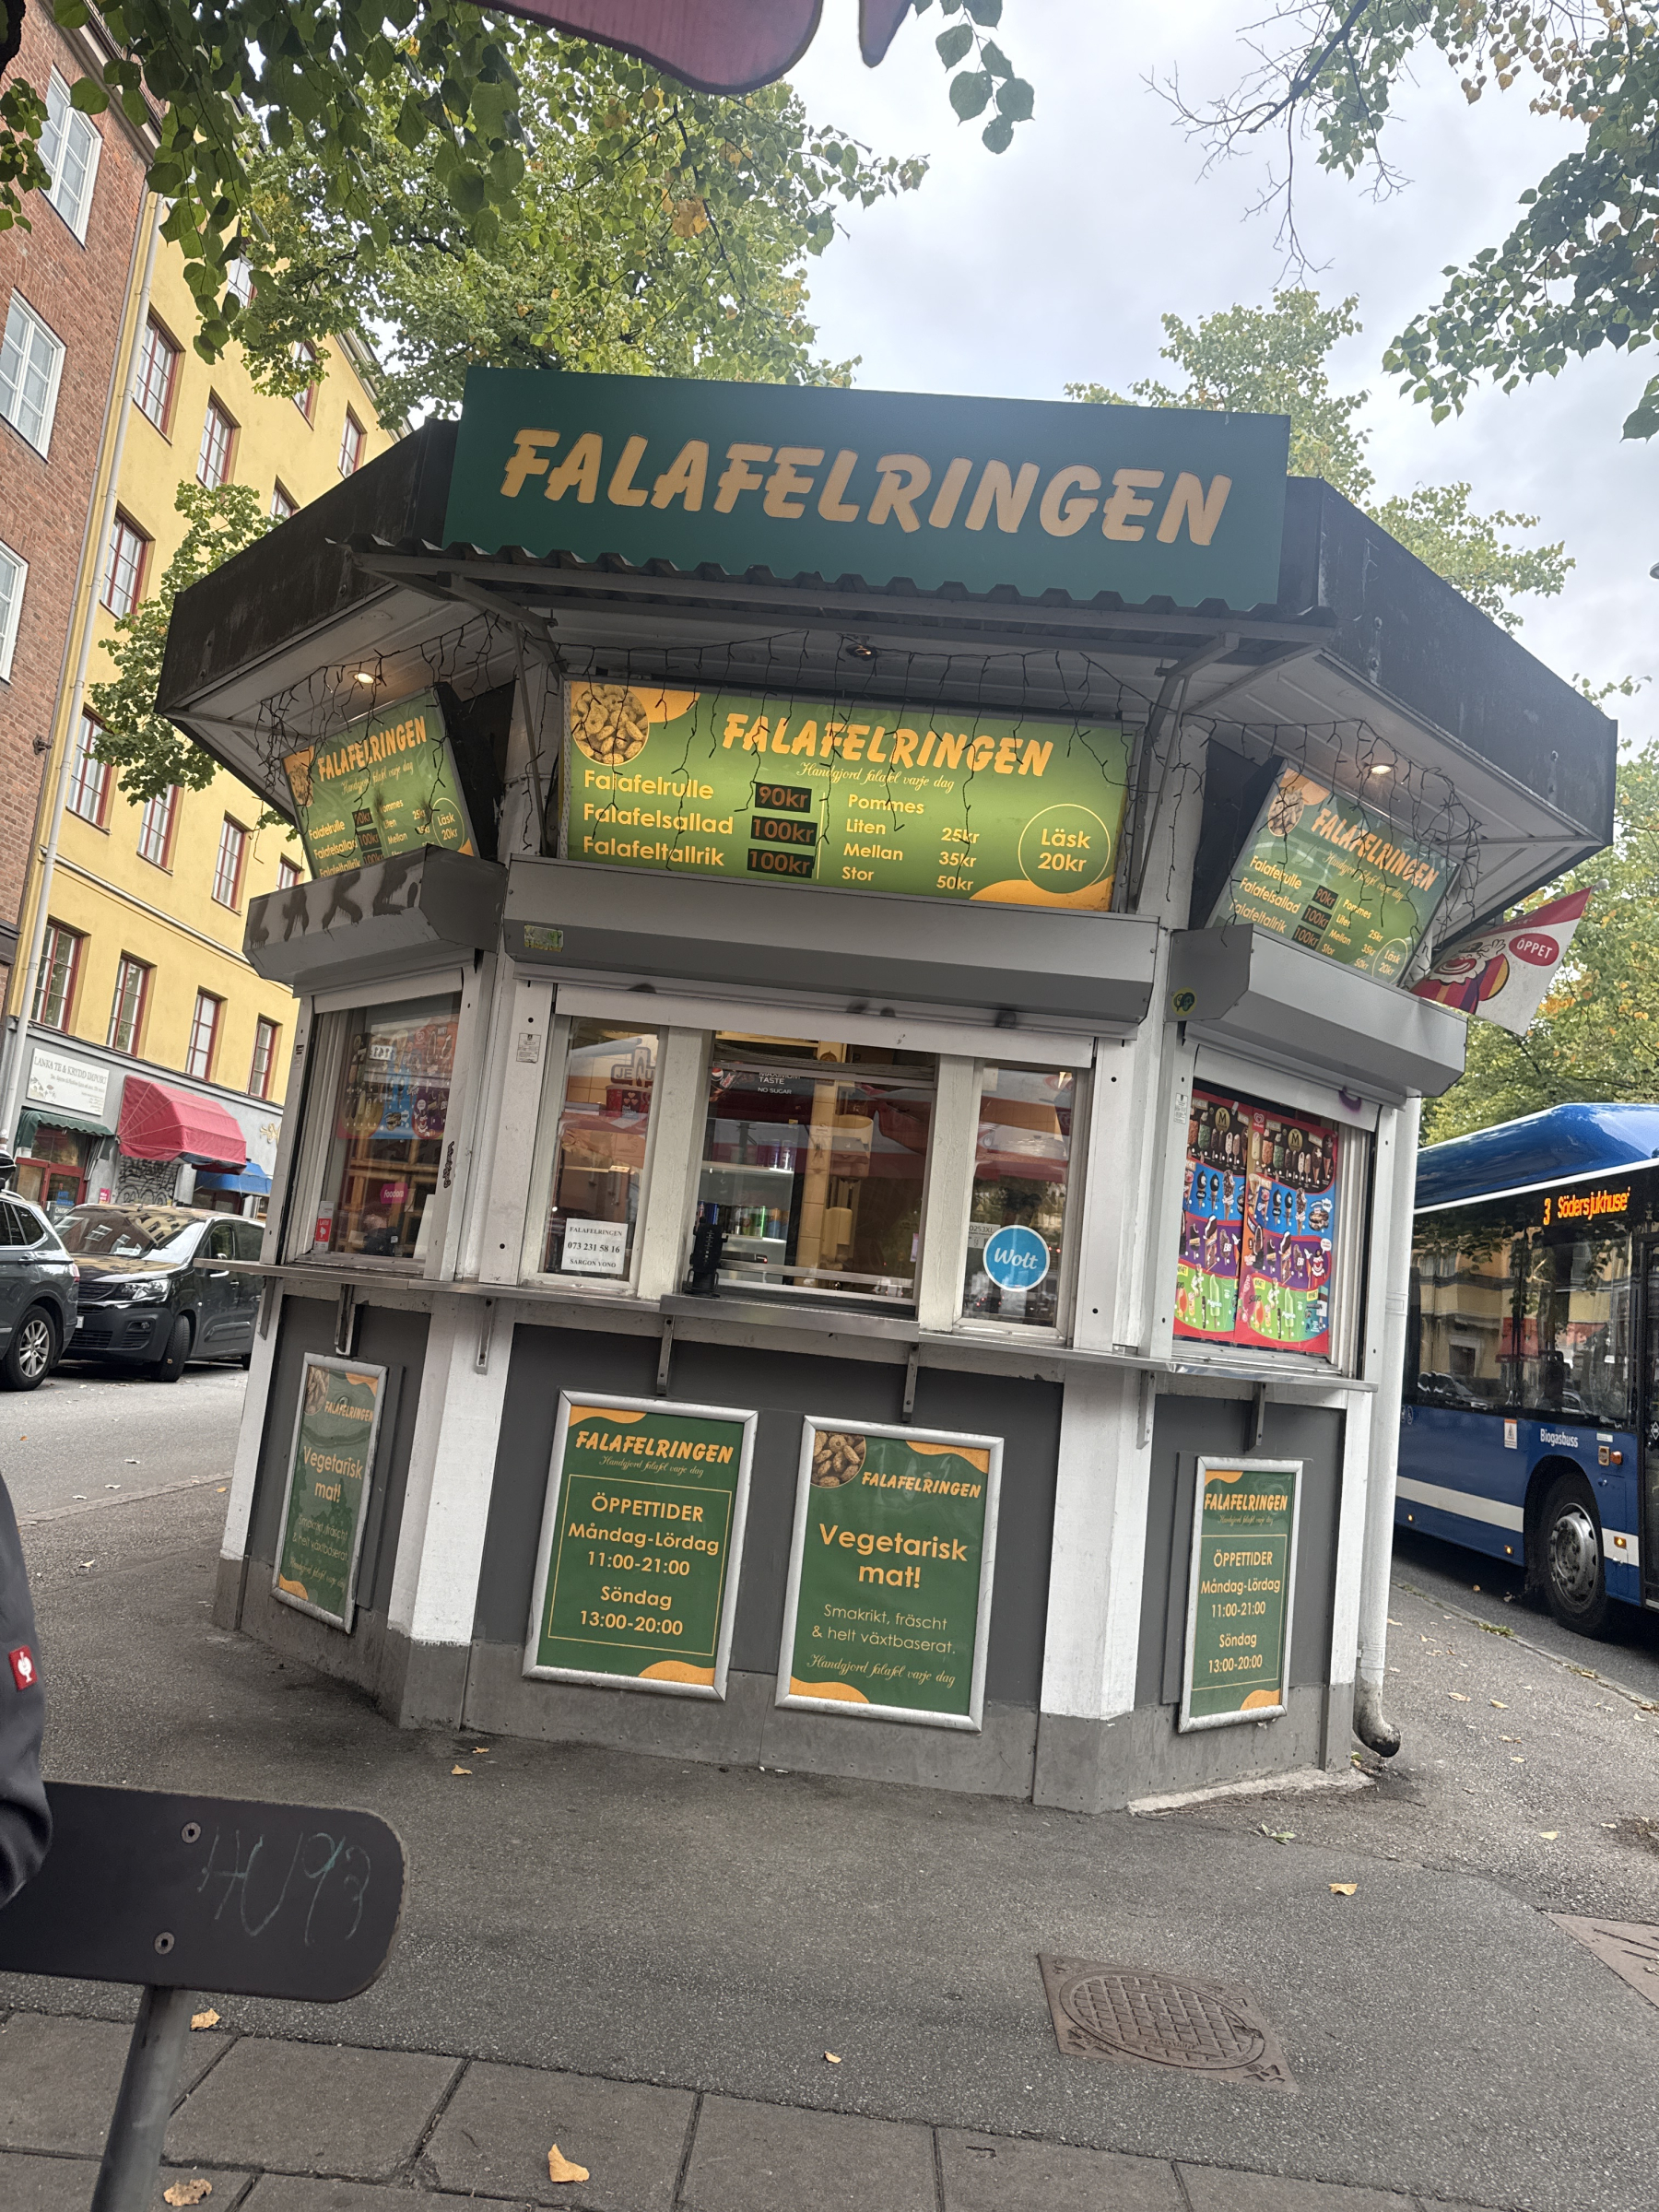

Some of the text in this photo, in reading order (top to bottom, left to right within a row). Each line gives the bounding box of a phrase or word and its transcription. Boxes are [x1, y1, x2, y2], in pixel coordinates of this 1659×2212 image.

[500, 427, 1233, 547] FALAFELRINGEN
[317, 715, 427, 782] FALAFELRINGEN
[723, 712, 1053, 777] FALAFELRINGEN
[584, 769, 714, 800] Falafelrulle
[796, 761, 955, 794] Handgjord falafel varje dag
[759, 788, 808, 809] 90kr
[848, 794, 924, 815] Pommes
[437, 813, 455, 827] Läsk
[583, 803, 734, 835] Falafelsallad
[753, 818, 815, 843] 100kr
[359, 832, 380, 847] 100kr
[441, 827, 458, 841] 20kr
[846, 818, 980, 844] Liten 25kr
[1041, 828, 1091, 850] Läsk
[583, 836, 724, 866] Falafeltallrik
[843, 843, 976, 868] Mellan 35kr
[1311, 807, 1440, 892] FALAFELRINGEN
[749, 850, 811, 876] 100kr
[1038, 852, 1087, 873] 20kr
[841, 865, 973, 892] Stor 50kr
[1239, 877, 1301, 913] Falafelsallad
[1314, 888, 1336, 906] 90kr
[1304, 907, 1330, 928] 100kr
[1293, 926, 1319, 947] 100kr
[1328, 928, 1376, 957] Mellan 35kr
[1368, 929, 1383, 942] 25kr
[1321, 943, 1335, 956] Stor
[1383, 949, 1401, 965] Läsk
[1516, 937, 1553, 959] ÖPPET
[1378, 961, 1394, 976] 20kr
[759, 1077, 785, 1085] TASTE
[383, 1188, 405, 1199] foodora
[1543, 1197, 1551, 1226] 3
[569, 1226, 622, 1237] FALAFELRINGEN
[567, 1241, 620, 1253] 073 231 58 16
[994, 1247, 1039, 1270] Wolt
[570, 1258, 596, 1266] SARGON
[324, 1400, 374, 1422] FALAFELRINGEN
[575, 1430, 734, 1464] FALAFELRINGEN
[1539, 1428, 1579, 1449] Biogasbuss
[303, 1445, 364, 1480] Vegetarisk
[598, 1454, 704, 1479] Handgjord falafel varje dag
[314, 1482, 342, 1503] mat!
[861, 1471, 982, 1500] FALAFELRINGEN
[591, 1491, 704, 1524] ÖPPETTIDER
[1204, 1493, 1288, 1512] FALAFELRINGEN
[568, 1522, 720, 1557] Måndag-Lördag
[818, 1523, 969, 1562] Vegetarisk
[587, 1550, 690, 1577] 11:00-21:00
[1213, 1548, 1273, 1568] ÖPPETTIDER
[858, 1565, 921, 1589] mat!
[1200, 1576, 1281, 1595] Måndag-Lördag
[600, 1585, 673, 1611] Söndag
[1211, 1600, 1266, 1618] 11:00-21:00
[580, 1609, 684, 1637] 13:00-20:00
[823, 1603, 947, 1631] Smakrikt, fräscht
[811, 1625, 957, 1655] & helt växtbaserat.
[1218, 1631, 1257, 1649] Söndag
[806, 1653, 956, 1688] Handgjord falafel varje dag
[1208, 1653, 1264, 1674] 13:00-20:00
